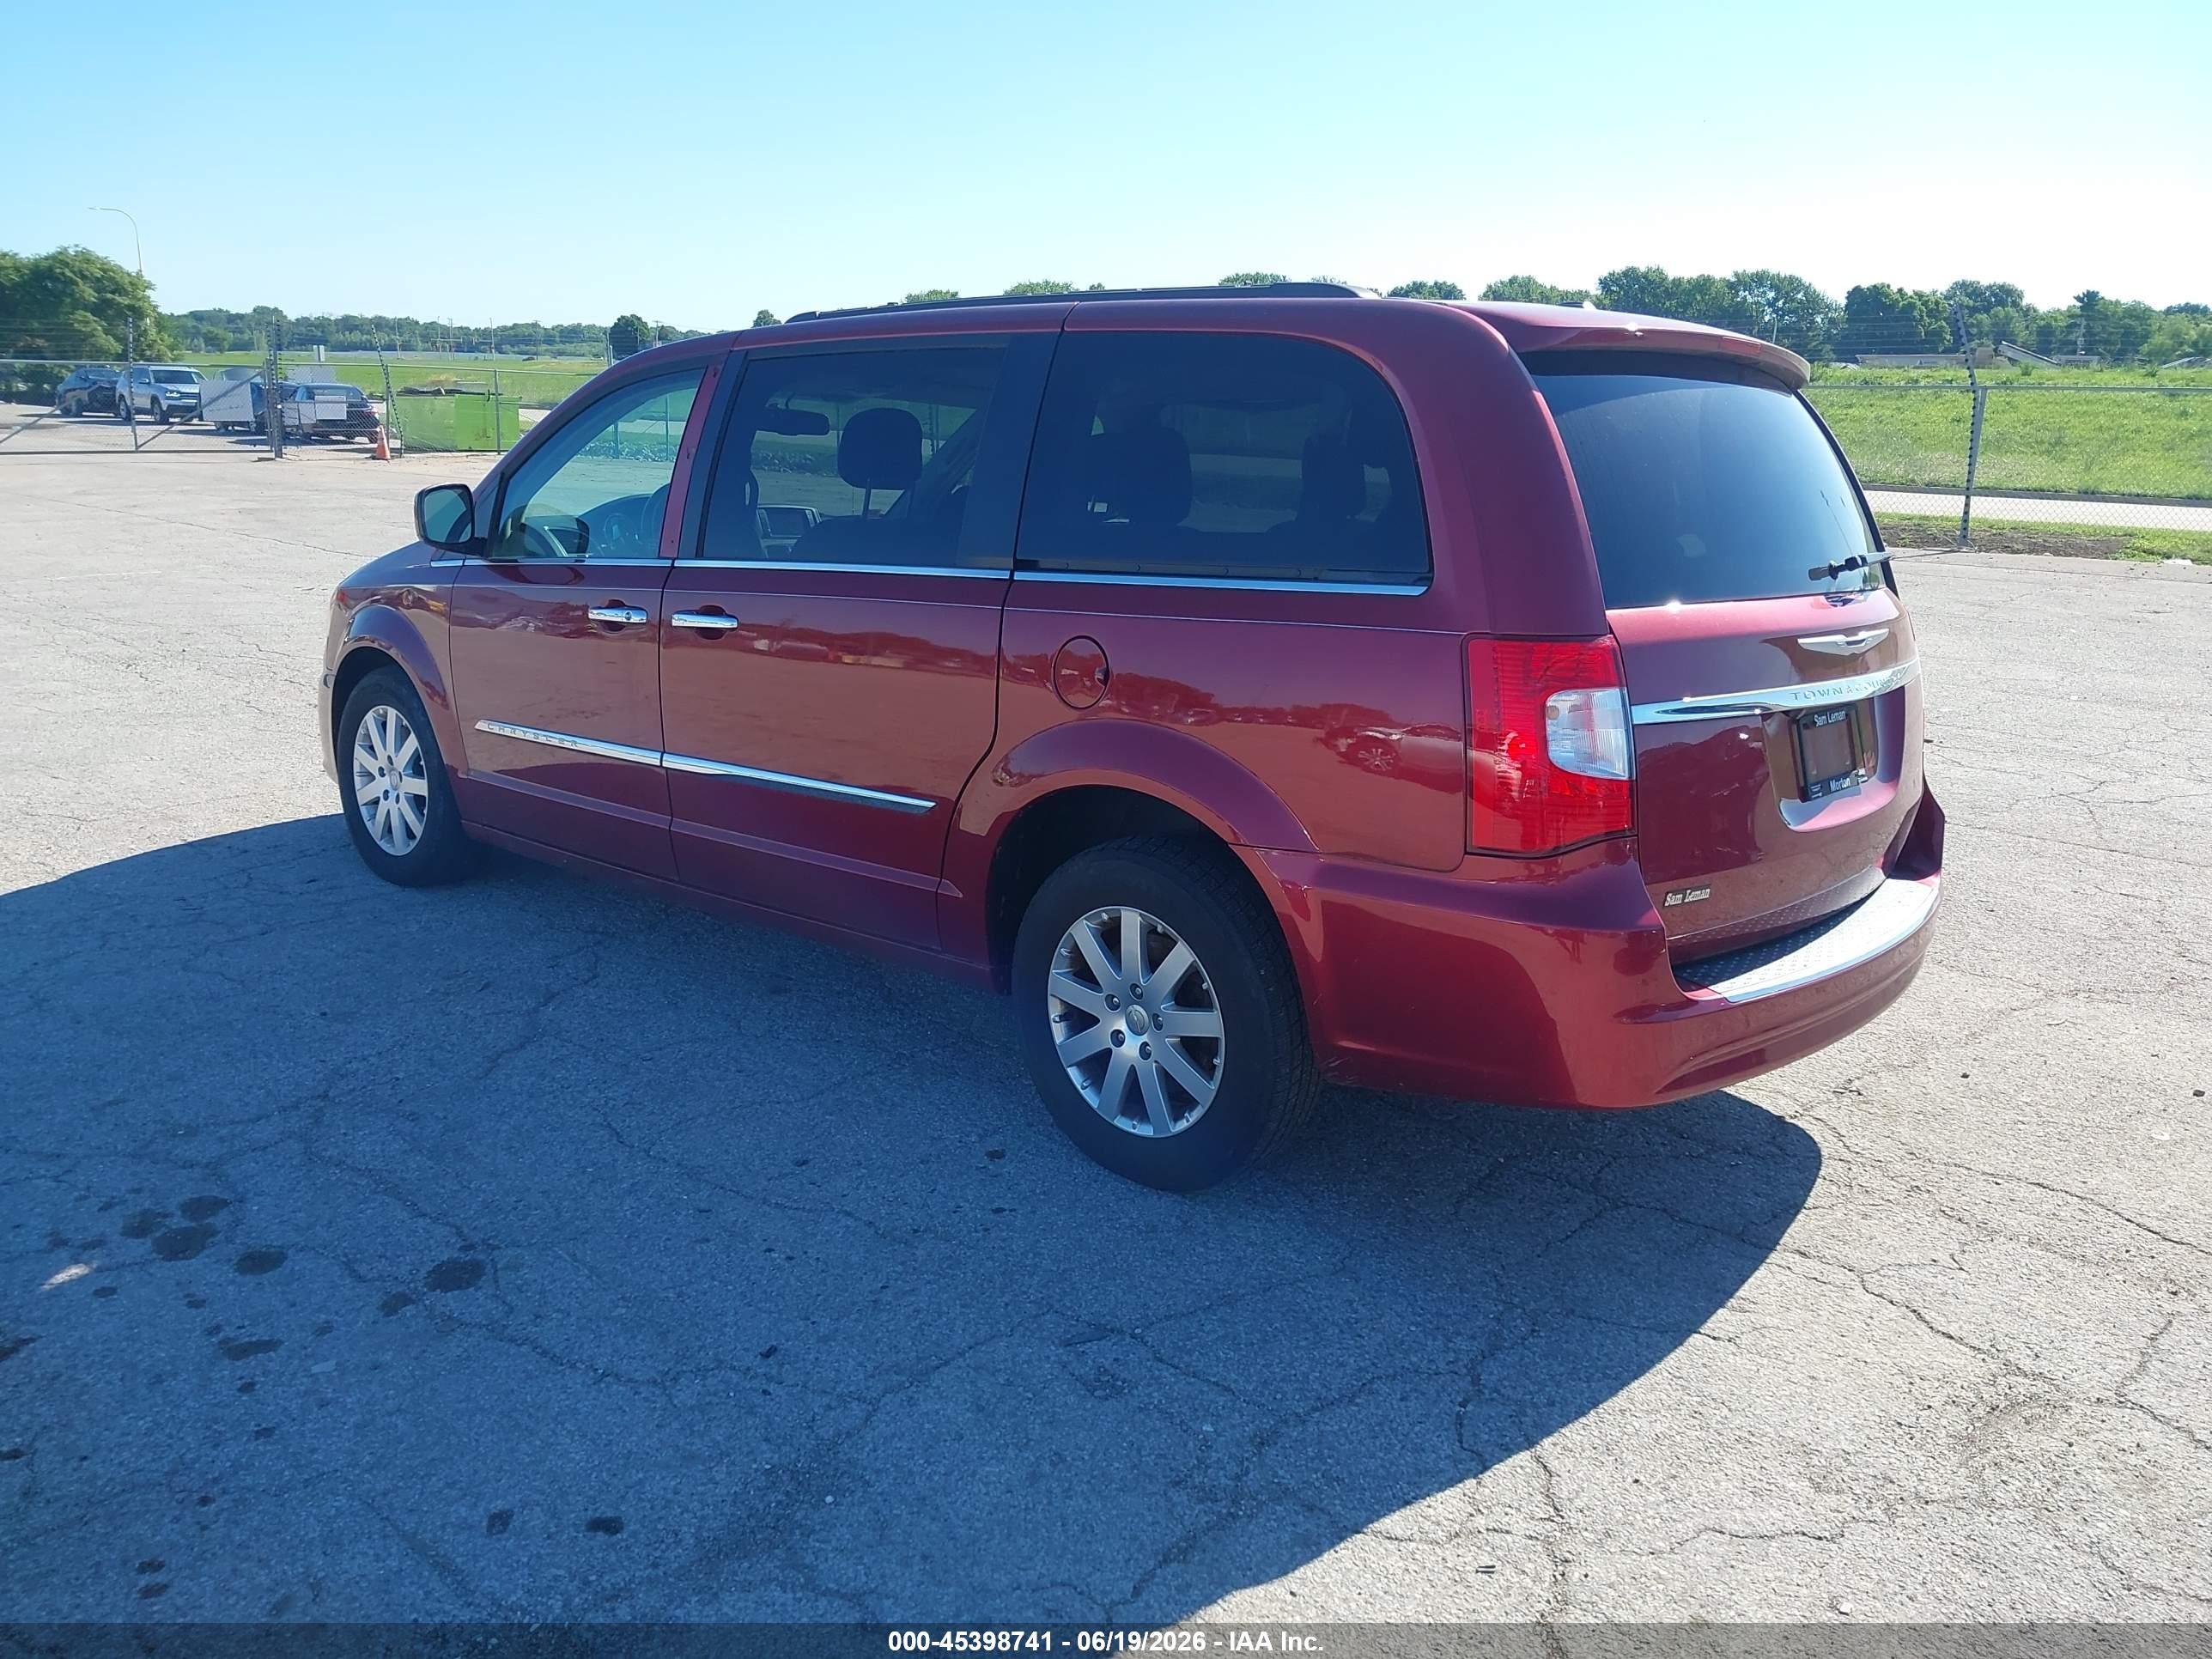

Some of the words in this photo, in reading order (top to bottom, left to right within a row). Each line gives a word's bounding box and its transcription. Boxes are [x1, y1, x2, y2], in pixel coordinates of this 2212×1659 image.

[1790, 688, 1843, 702] TOWN
[1814, 714, 1827, 727] Sam
[1826, 710, 1846, 723] Leman
[487, 722, 578, 748] CHRYSLER
[1829, 777, 1851, 792] Morton
[1664, 892, 1683, 907] Sam
[1683, 888, 1711, 902] Leman
